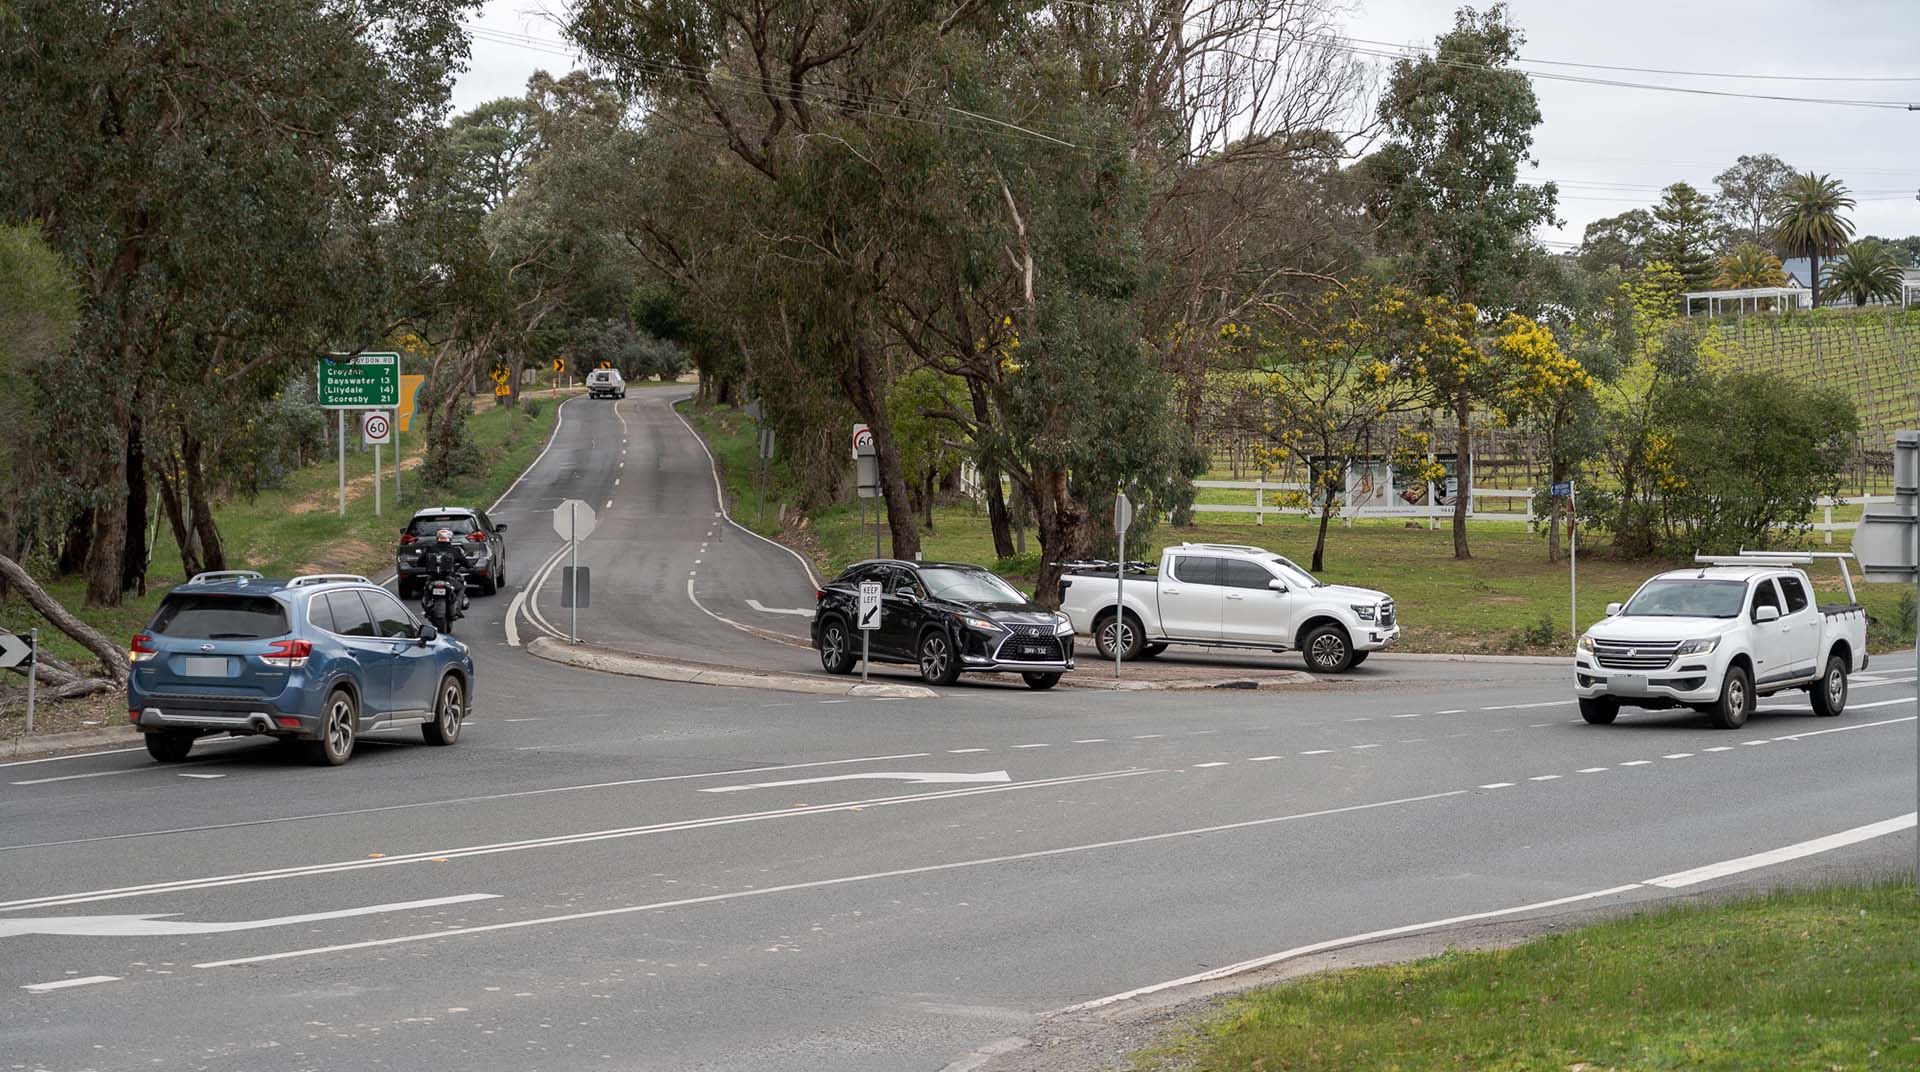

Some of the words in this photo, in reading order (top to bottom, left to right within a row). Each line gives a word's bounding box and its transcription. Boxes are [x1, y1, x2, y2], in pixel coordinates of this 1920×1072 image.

[324, 385, 363, 395] (Lilydale
[380, 385, 394, 394] 14)
[370, 422, 385, 433] 60
[863, 586, 879, 594] KEEP
[863, 595, 878, 604] LEFT
